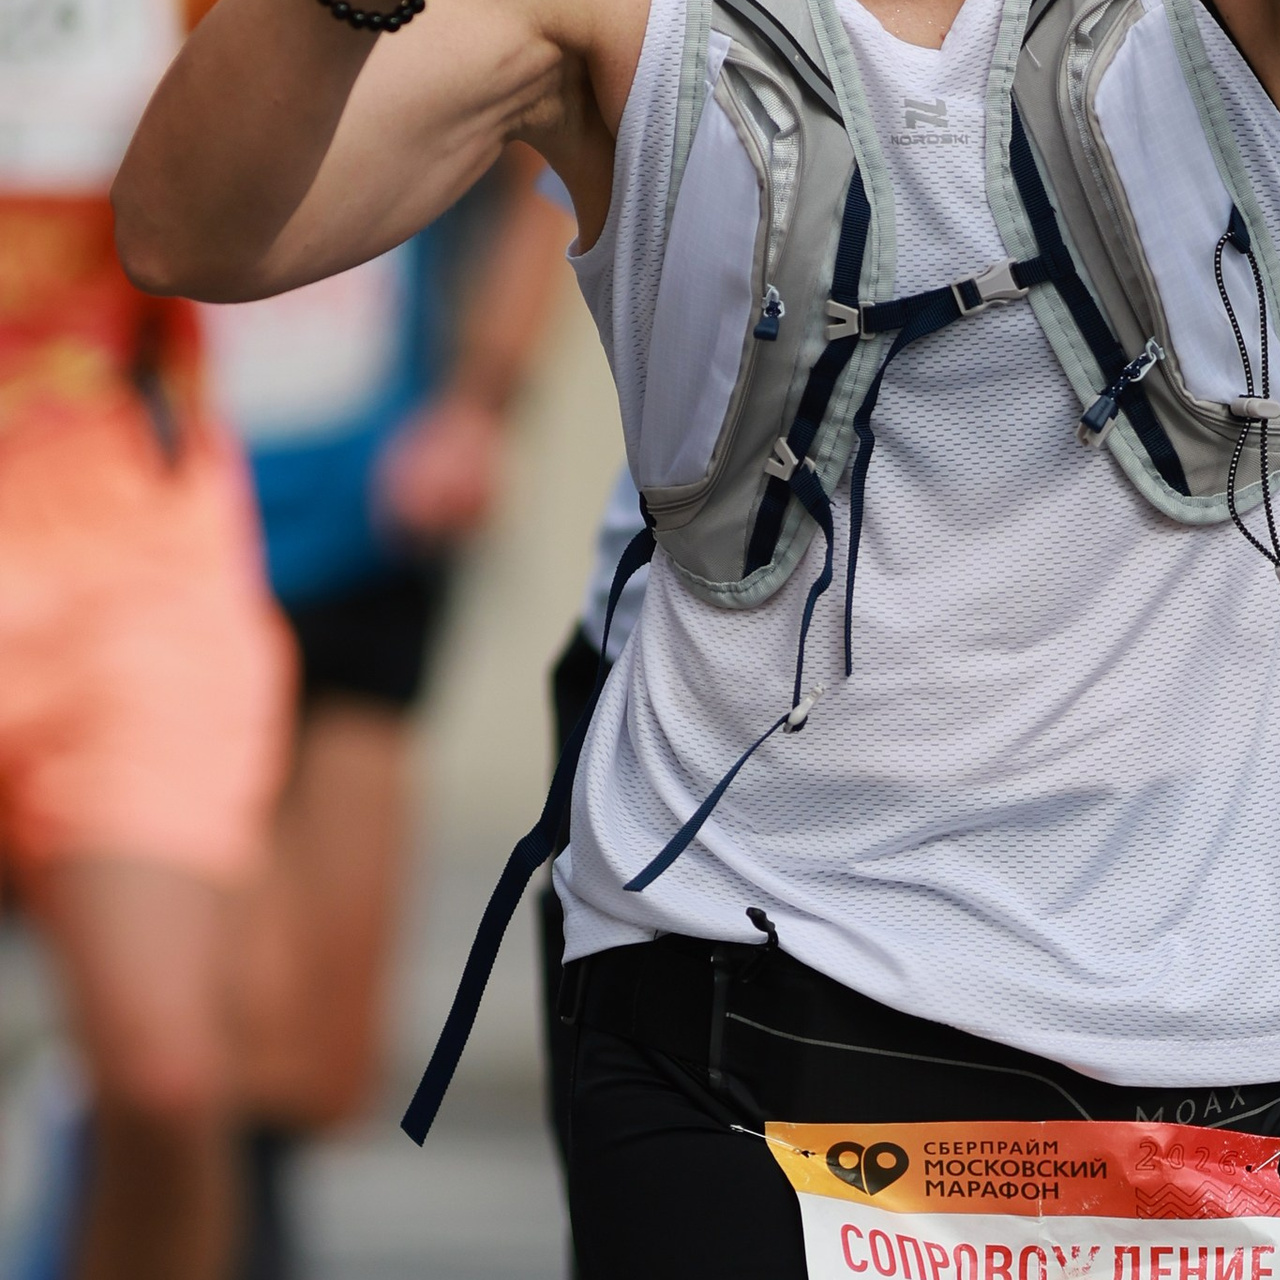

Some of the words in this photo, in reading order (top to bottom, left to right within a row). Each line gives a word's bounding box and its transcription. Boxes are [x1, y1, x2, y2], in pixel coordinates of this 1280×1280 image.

[889, 133, 969, 146] NORDSKI
[1135, 1086, 1246, 1124] MOAX
[923, 1138, 1059, 1156] СБЕРПРАЙМ
[1135, 1138, 1240, 1175] 2026
[924, 1158, 1108, 1180] МОСКОВСКИЙ
[924, 1180, 1060, 1200] МАРАФОН
